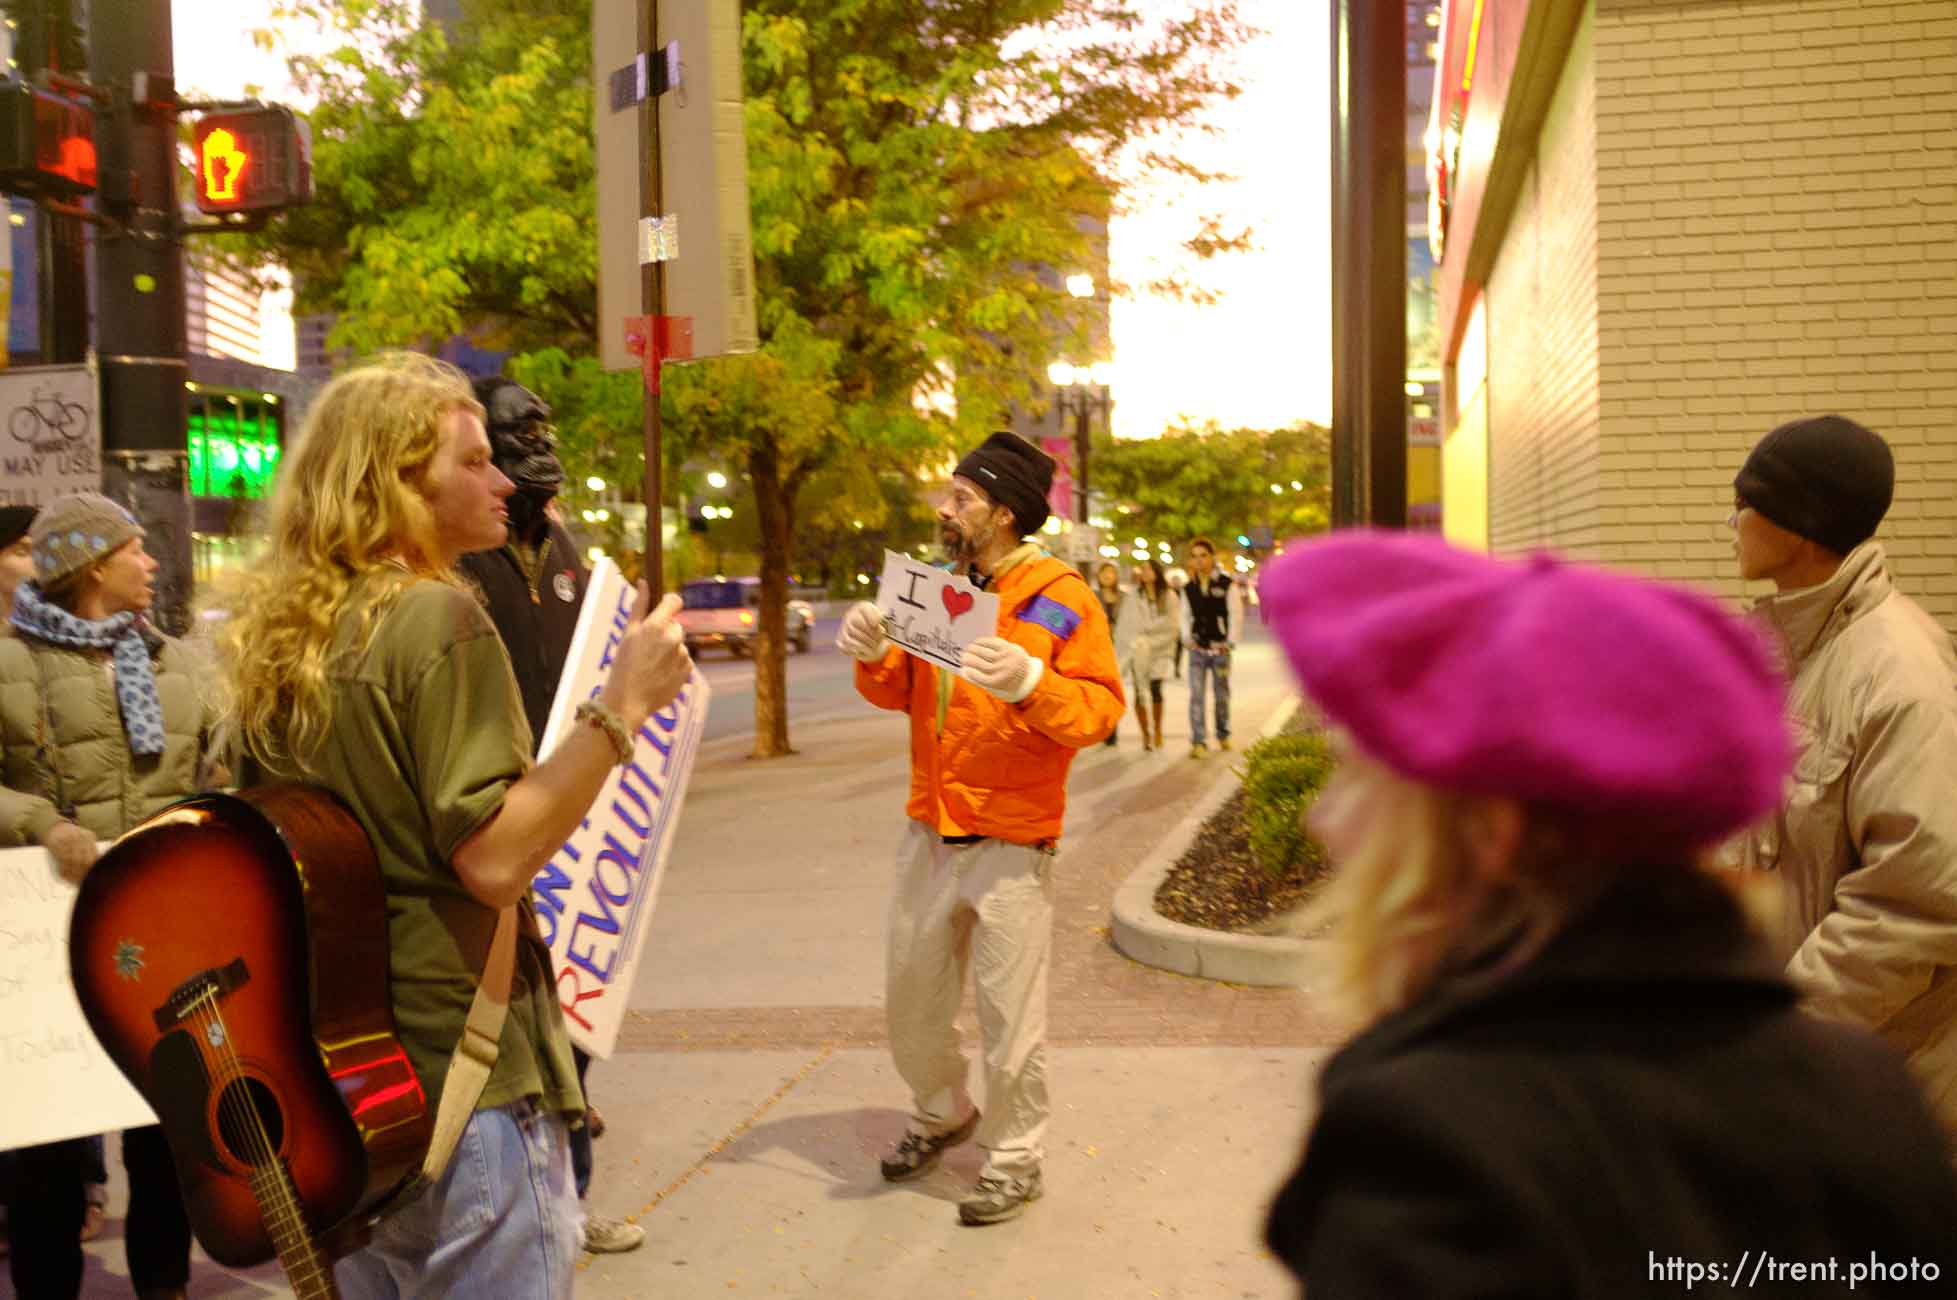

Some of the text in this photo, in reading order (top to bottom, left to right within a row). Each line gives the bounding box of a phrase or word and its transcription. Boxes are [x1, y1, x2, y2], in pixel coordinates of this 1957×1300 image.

[5, 456, 45, 476] MAY
[897, 568, 929, 610] I
[557, 672, 694, 1032] REVOLUTIO
